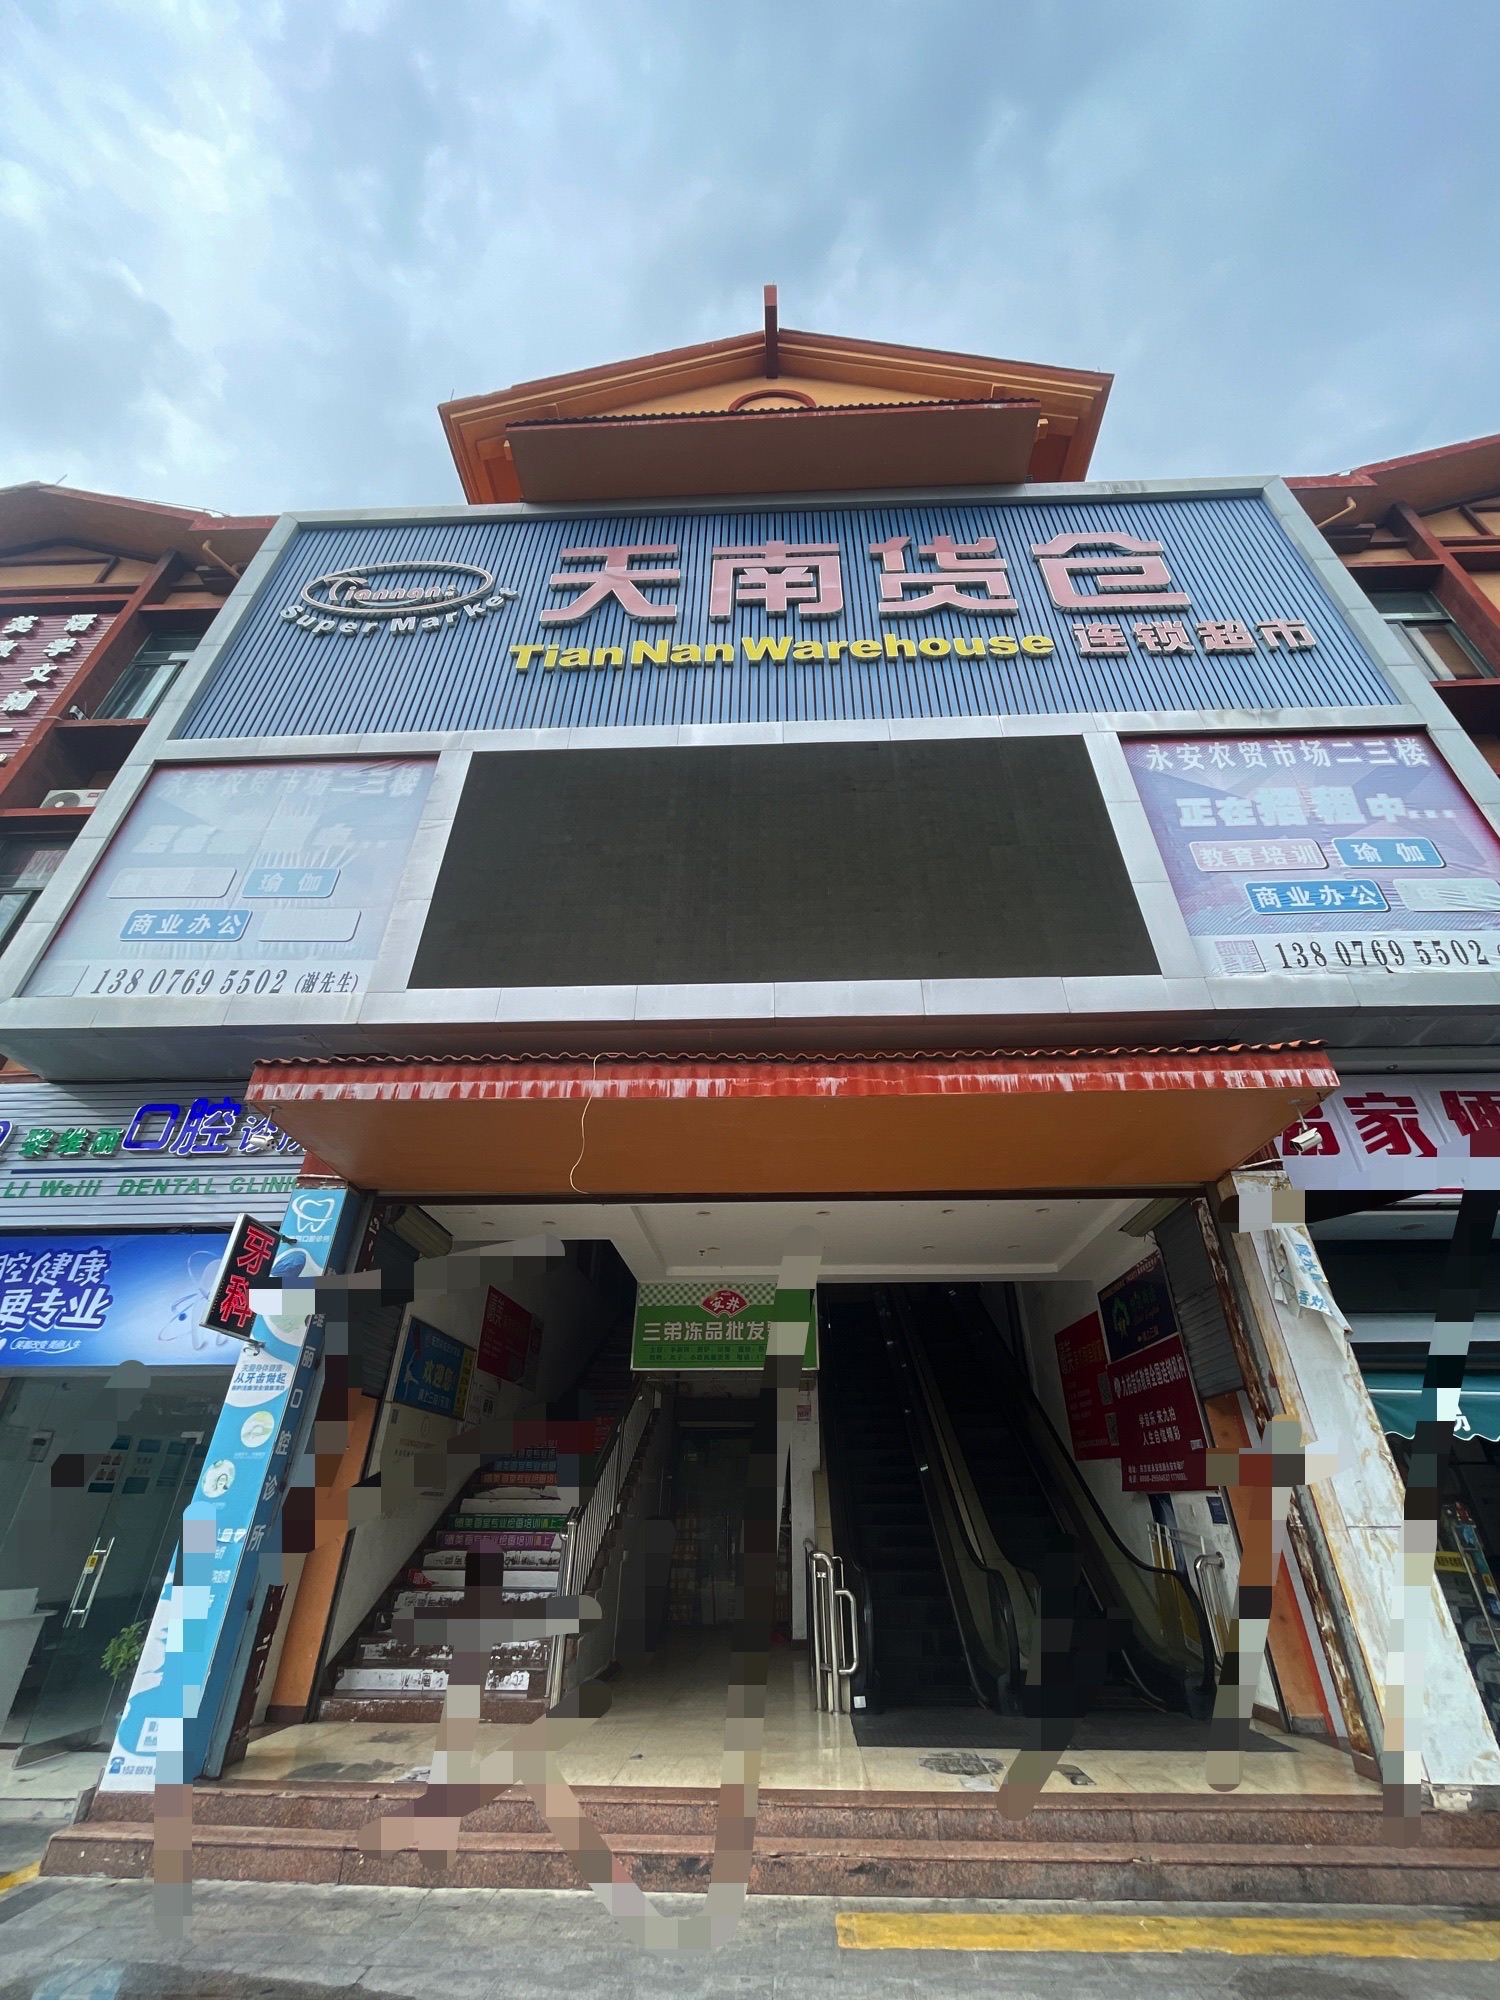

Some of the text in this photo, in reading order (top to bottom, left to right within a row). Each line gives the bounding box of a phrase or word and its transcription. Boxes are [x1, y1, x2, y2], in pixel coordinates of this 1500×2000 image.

[540, 532, 1192, 628] 天南货仓
[280, 586, 519, 635] Super Market
[1073, 617, 1317, 657] 连锁超市
[1146, 738, 1431, 770] 永安农贸市场二三楼
[1200, 843, 1322, 867] 教育培训
[1252, 885, 1379, 908] 商业办公
[127, 913, 243, 936] 商业办公
[117, 1178, 217, 1196] DENTAL
[0, 1249, 108, 1287] 腔健康
[219, 1225, 275, 1328] 牙科
[0, 1287, 110, 1326] 更专业
[710, 1296, 740, 1312] 安井
[643, 1320, 772, 1341] 三弟冻品批发
[234, 1372, 287, 1384] 从牙齿做起
[1143, 1425, 1181, 1446] 人生自信精彩
